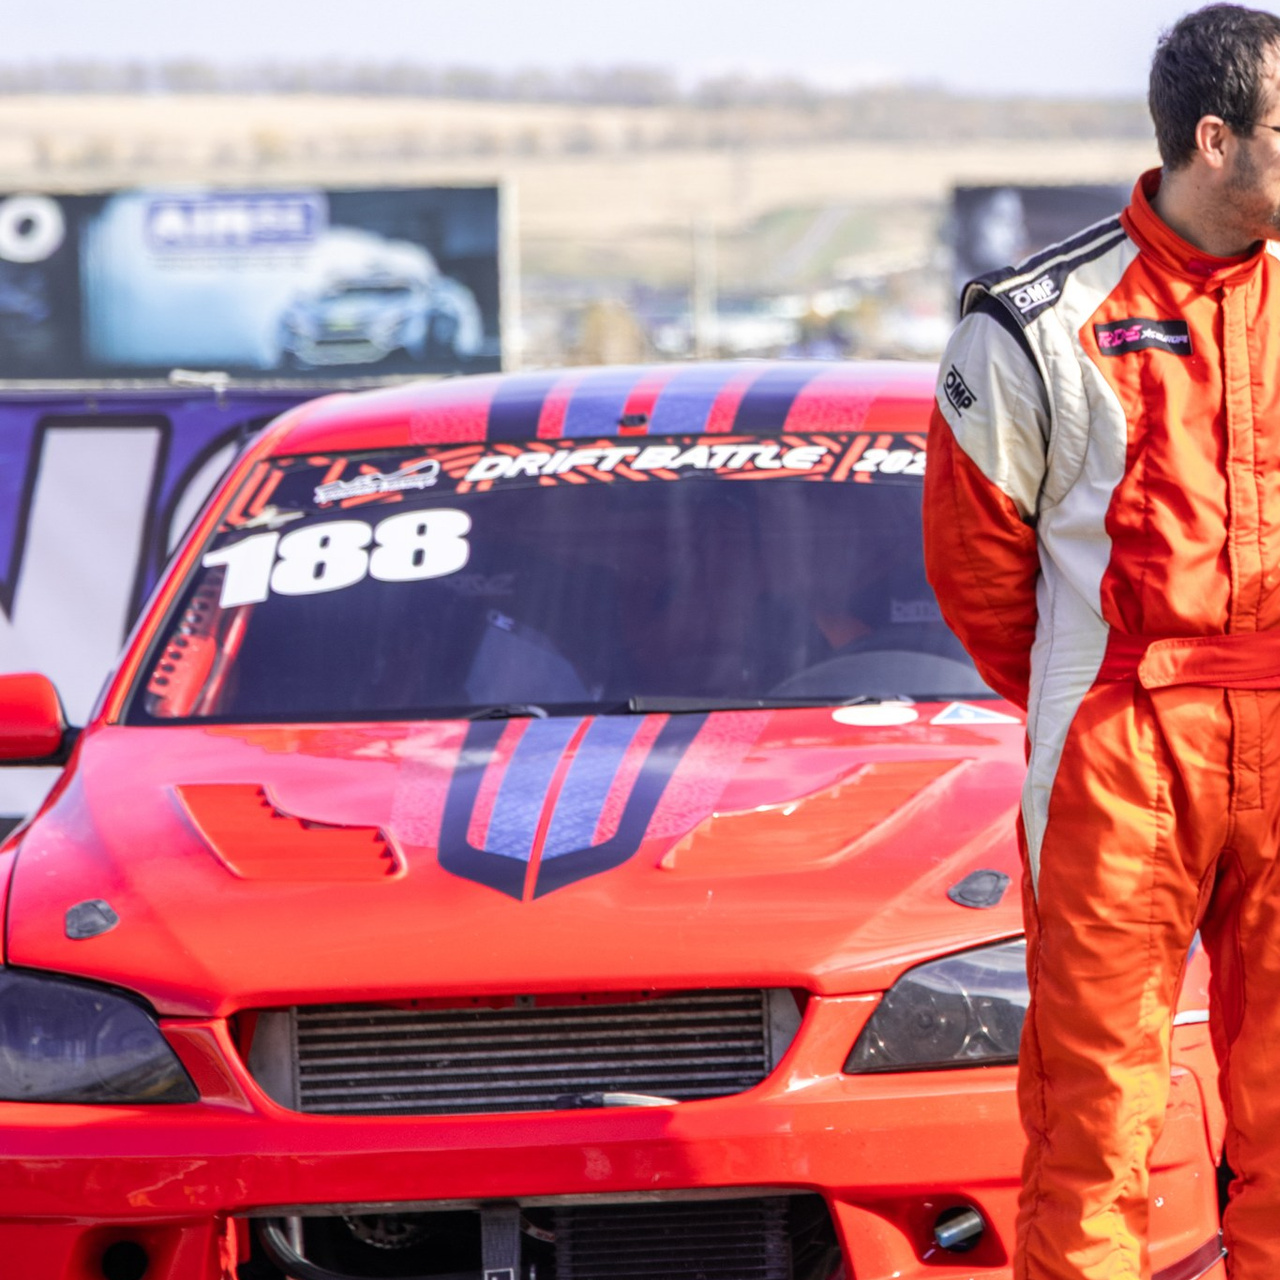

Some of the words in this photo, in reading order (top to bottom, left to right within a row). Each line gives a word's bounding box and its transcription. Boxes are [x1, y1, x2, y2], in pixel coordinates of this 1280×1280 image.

[1011, 276, 1058, 311] OMP
[943, 368, 975, 411] OMP
[465, 445, 638, 482] DRIFT
[630, 443, 829, 471] BATTLE
[203, 508, 471, 608] 188
